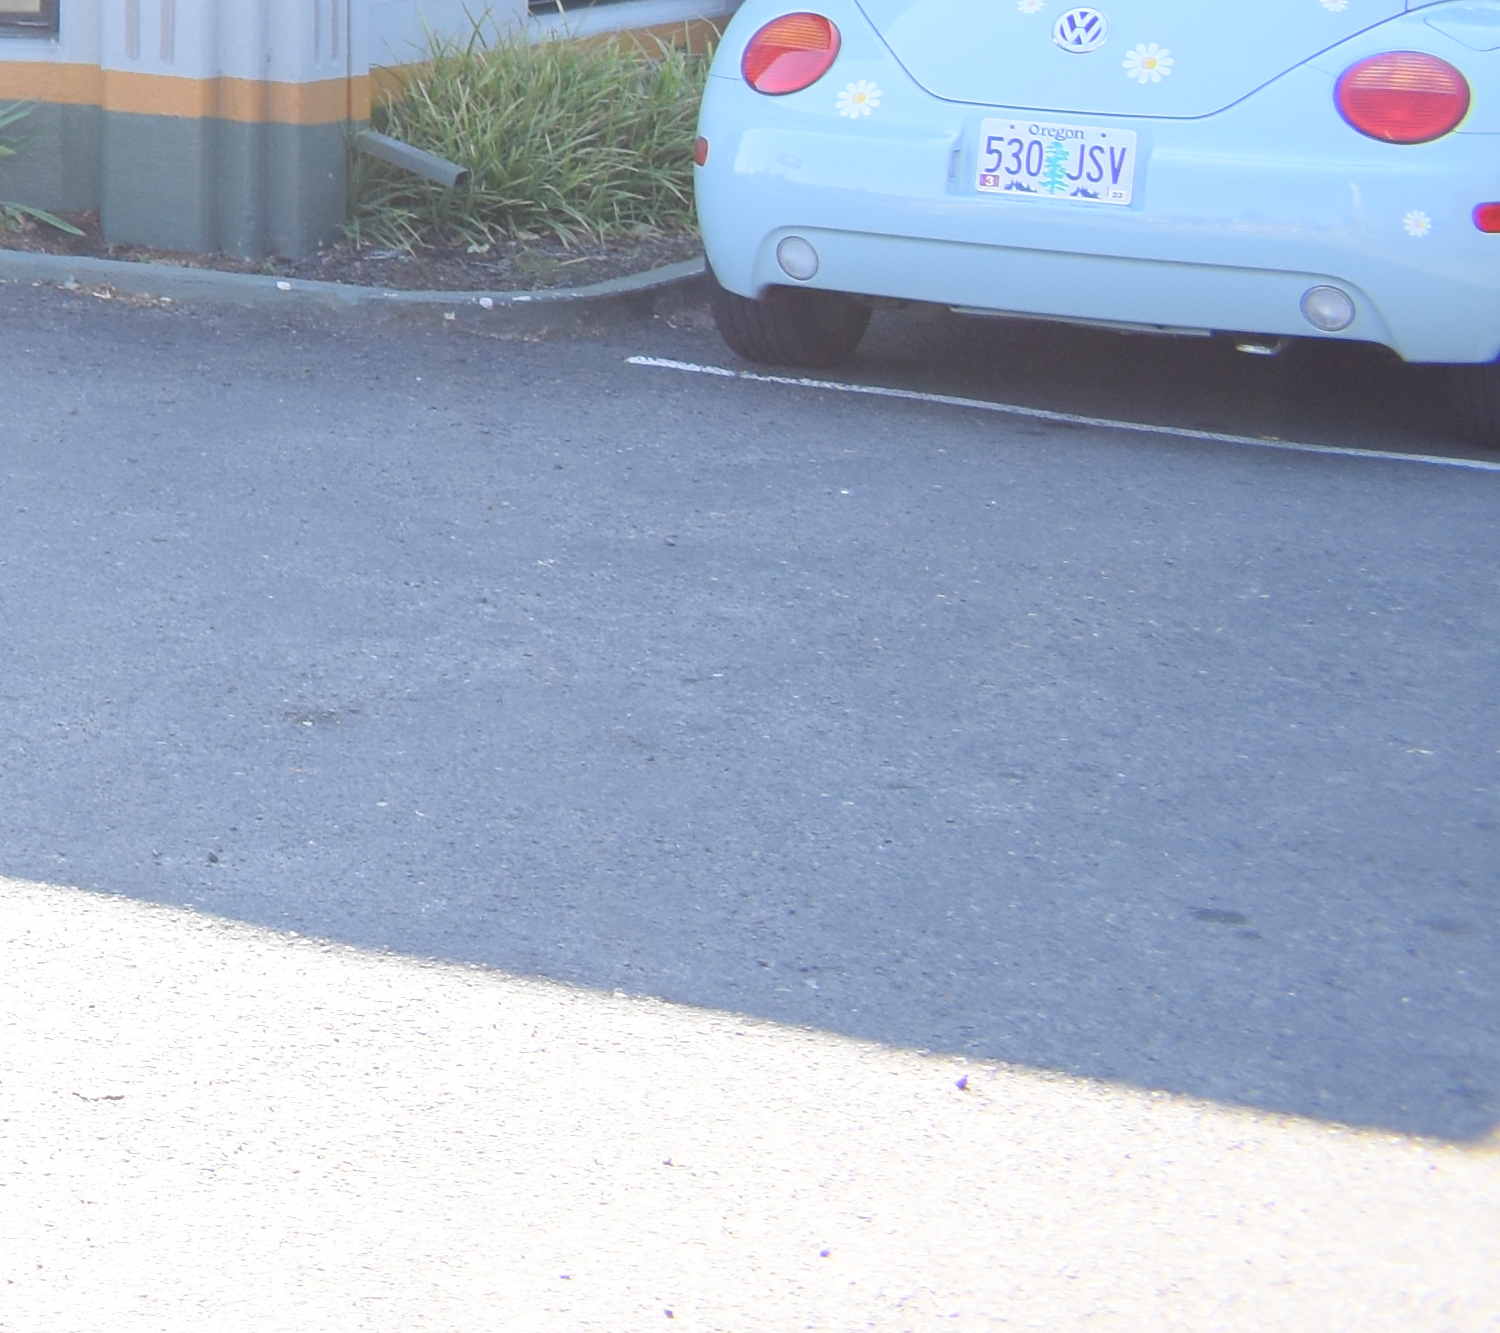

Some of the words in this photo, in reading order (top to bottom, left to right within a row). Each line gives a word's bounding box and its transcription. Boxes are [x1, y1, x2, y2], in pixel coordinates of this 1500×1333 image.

[1028, 124, 1085, 141] Oregon
[984, 136, 1044, 177] 530
[1065, 144, 1127, 185] JSV
